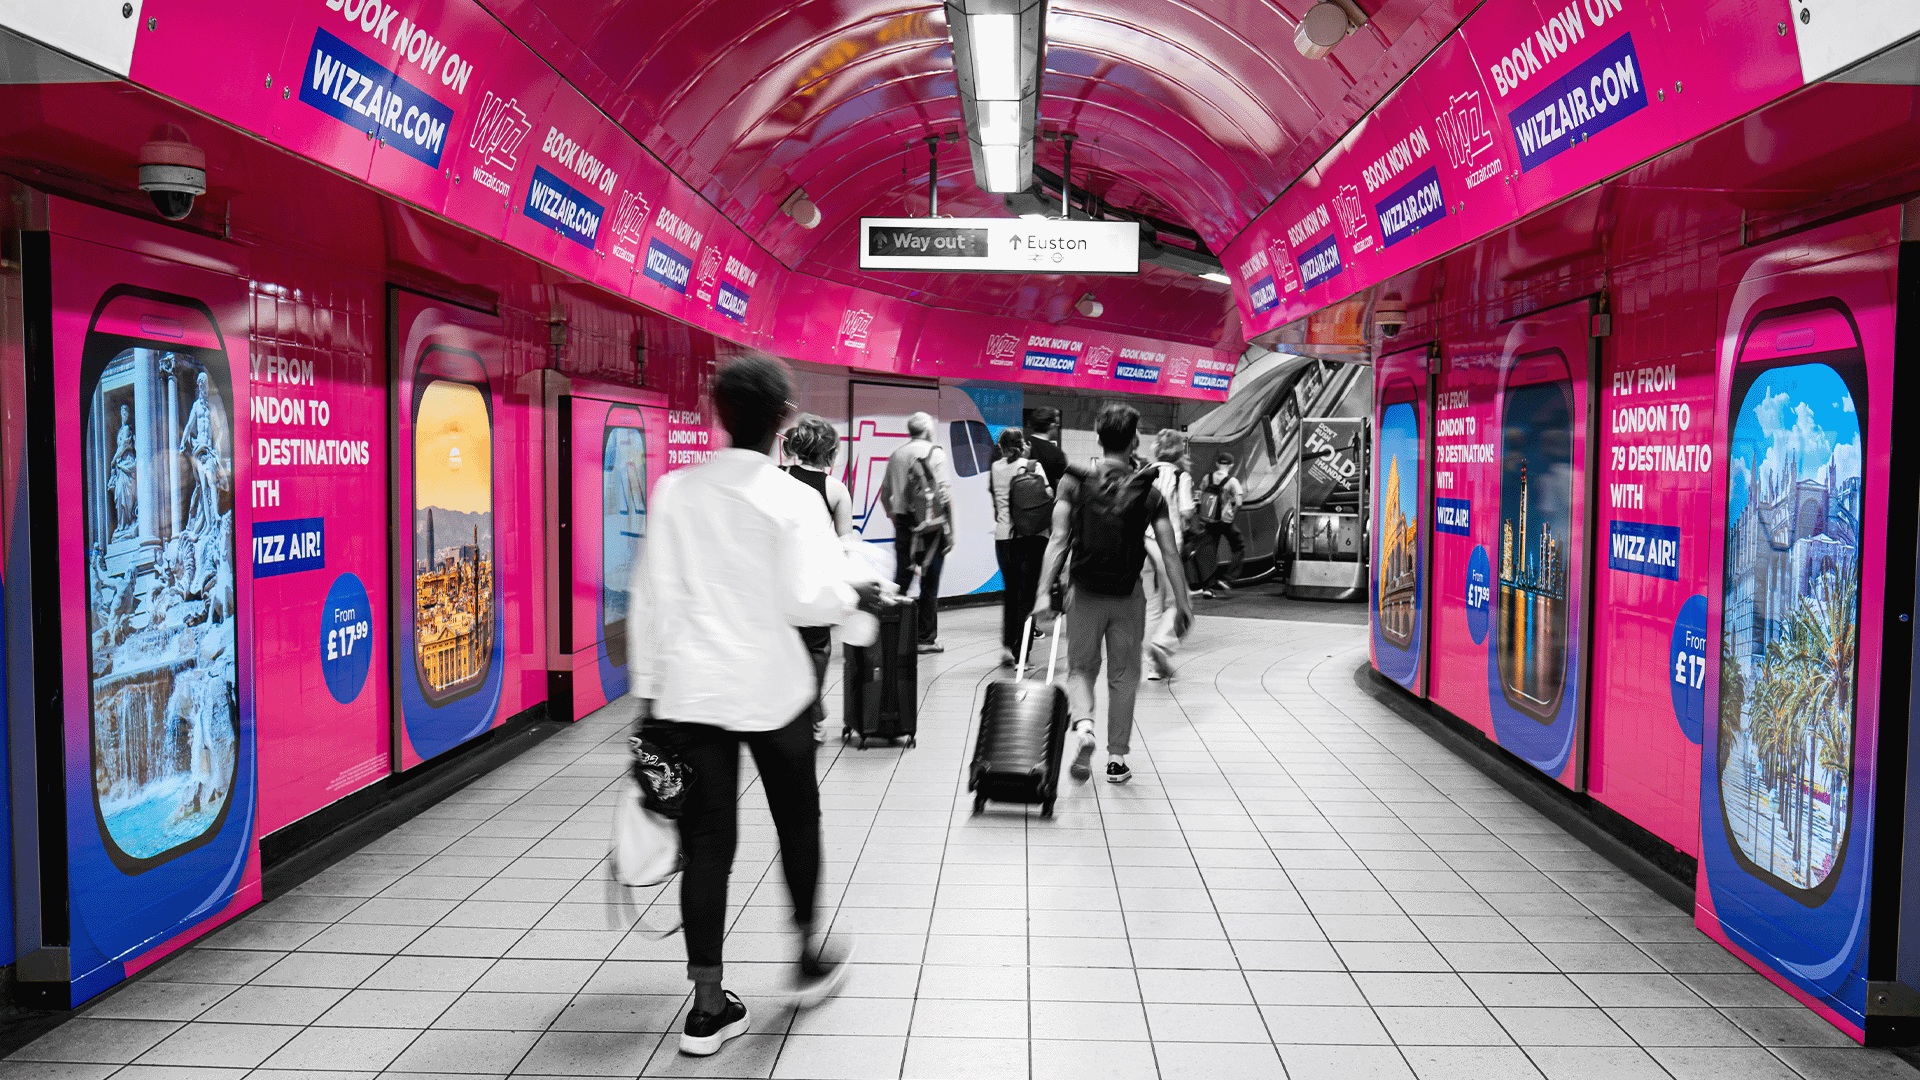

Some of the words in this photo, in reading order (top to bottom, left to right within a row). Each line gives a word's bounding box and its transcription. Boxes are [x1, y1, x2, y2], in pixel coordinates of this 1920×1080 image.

[391, 17, 447, 75] NOW
[441, 53, 473, 95] ON
[1490, 36, 1543, 97] BOOK
[1534, 0, 1585, 64] NOW
[313, 49, 445, 155] WIZZAIR.COM
[1515, 54, 1639, 157] WIZZAIR.COM
[542, 125, 580, 170] BOOK
[573, 149, 605, 185] NOW
[599, 168, 618, 196] ON
[1362, 155, 1393, 193] BOOK
[1385, 138, 1414, 176] NOW
[1409, 125, 1431, 158] ON
[472, 165, 510, 197] wizzair.com
[1464, 158, 1503, 190] wizzair.com
[530, 179, 599, 240] WIZZAIR.COM
[1379, 180, 1442, 237] WIZZAIR.COM
[655, 206, 680, 237] BOOK
[674, 219, 695, 245] NOW
[690, 230, 704, 252] ON
[1287, 221, 1308, 248] BOOK
[1301, 210, 1321, 238] NOW
[1316, 203, 1331, 227] ON
[893, 232, 930, 252] Way
[934, 235, 966, 250] out
[1027, 235, 1087, 250] Euston
[647, 246, 690, 287] WIZZAIR.COM
[1300, 244, 1340, 283] WIZZAIR.COM
[1027, 335, 1052, 348] BOOK
[1050, 338, 1071, 350] NOW
[1070, 341, 1083, 352] ON
[1119, 348, 1141, 360] BOOK
[1139, 351, 1156, 362] NOW
[1154, 352, 1166, 363] ON
[266, 355, 314, 386] FROM
[1025, 355, 1075, 370] WIZZAIR.COM
[1116, 365, 1160, 380] WIZZAIR.COM
[1193, 375, 1230, 388] WIZZAIR.COM
[1613, 369, 1635, 397] FLY
[1637, 364, 1676, 394] FROM
[308, 400, 330, 427] TO
[1437, 391, 1450, 411] FLY
[1450, 389, 1469, 410] FROM
[668, 410, 681, 424] FLY
[681, 410, 701, 426] FROM
[1318, 422, 1338, 438] DON'T
[1437, 418, 1465, 437] LONDON
[1465, 416, 1476, 436] TO
[1612, 404, 1667, 434] LONDON
[1670, 403, 1690, 432] TO
[668, 430, 697, 444] LONDON
[697, 431, 709, 445] TO
[1314, 427, 1331, 442] RUSH
[258, 438, 370, 466] DESTINATIONS
[668, 450, 677, 464] 79
[1304, 432, 1356, 478] HOLD
[1437, 445, 1445, 463] 79
[1611, 445, 1626, 471] 79
[1628, 444, 1711, 472] DESTINATIO
[1436, 471, 1454, 489] WITH
[1610, 483, 1643, 510] WITH
[1437, 506, 1454, 526] WIZZ
[1454, 509, 1469, 528] AIR!
[289, 531, 321, 560] AIR!
[1612, 533, 1646, 563] WIZZ
[1647, 537, 1676, 568] AIR!
[334, 607, 356, 623] From
